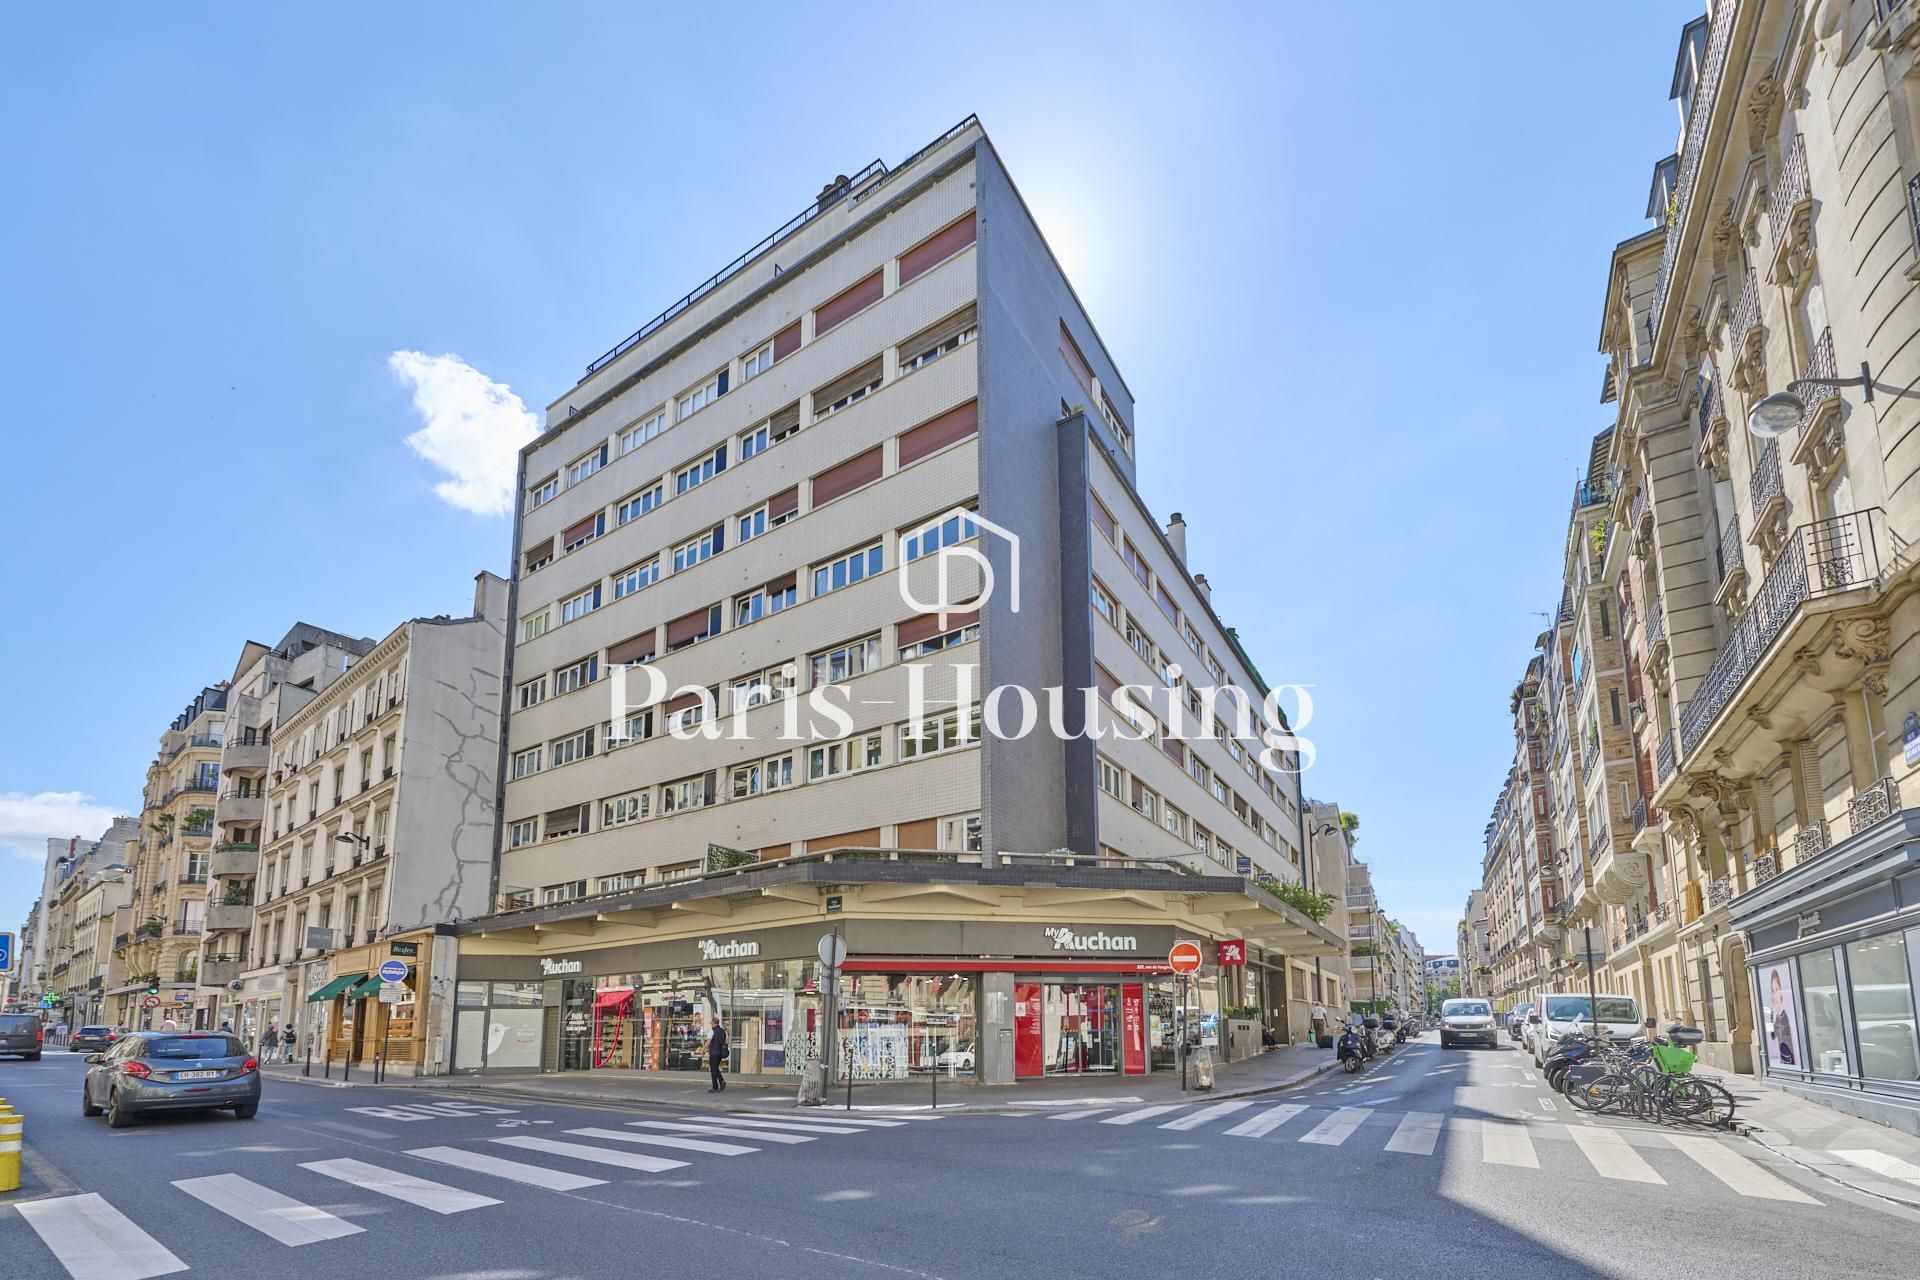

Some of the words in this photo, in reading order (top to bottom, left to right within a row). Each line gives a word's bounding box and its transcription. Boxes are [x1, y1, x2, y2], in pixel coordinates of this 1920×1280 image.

[1044, 927, 1059, 939] My
[1053, 928, 1137, 950] Auchan
[702, 939, 760, 961] Auchan
[343, 1101, 522, 1122] BUS
